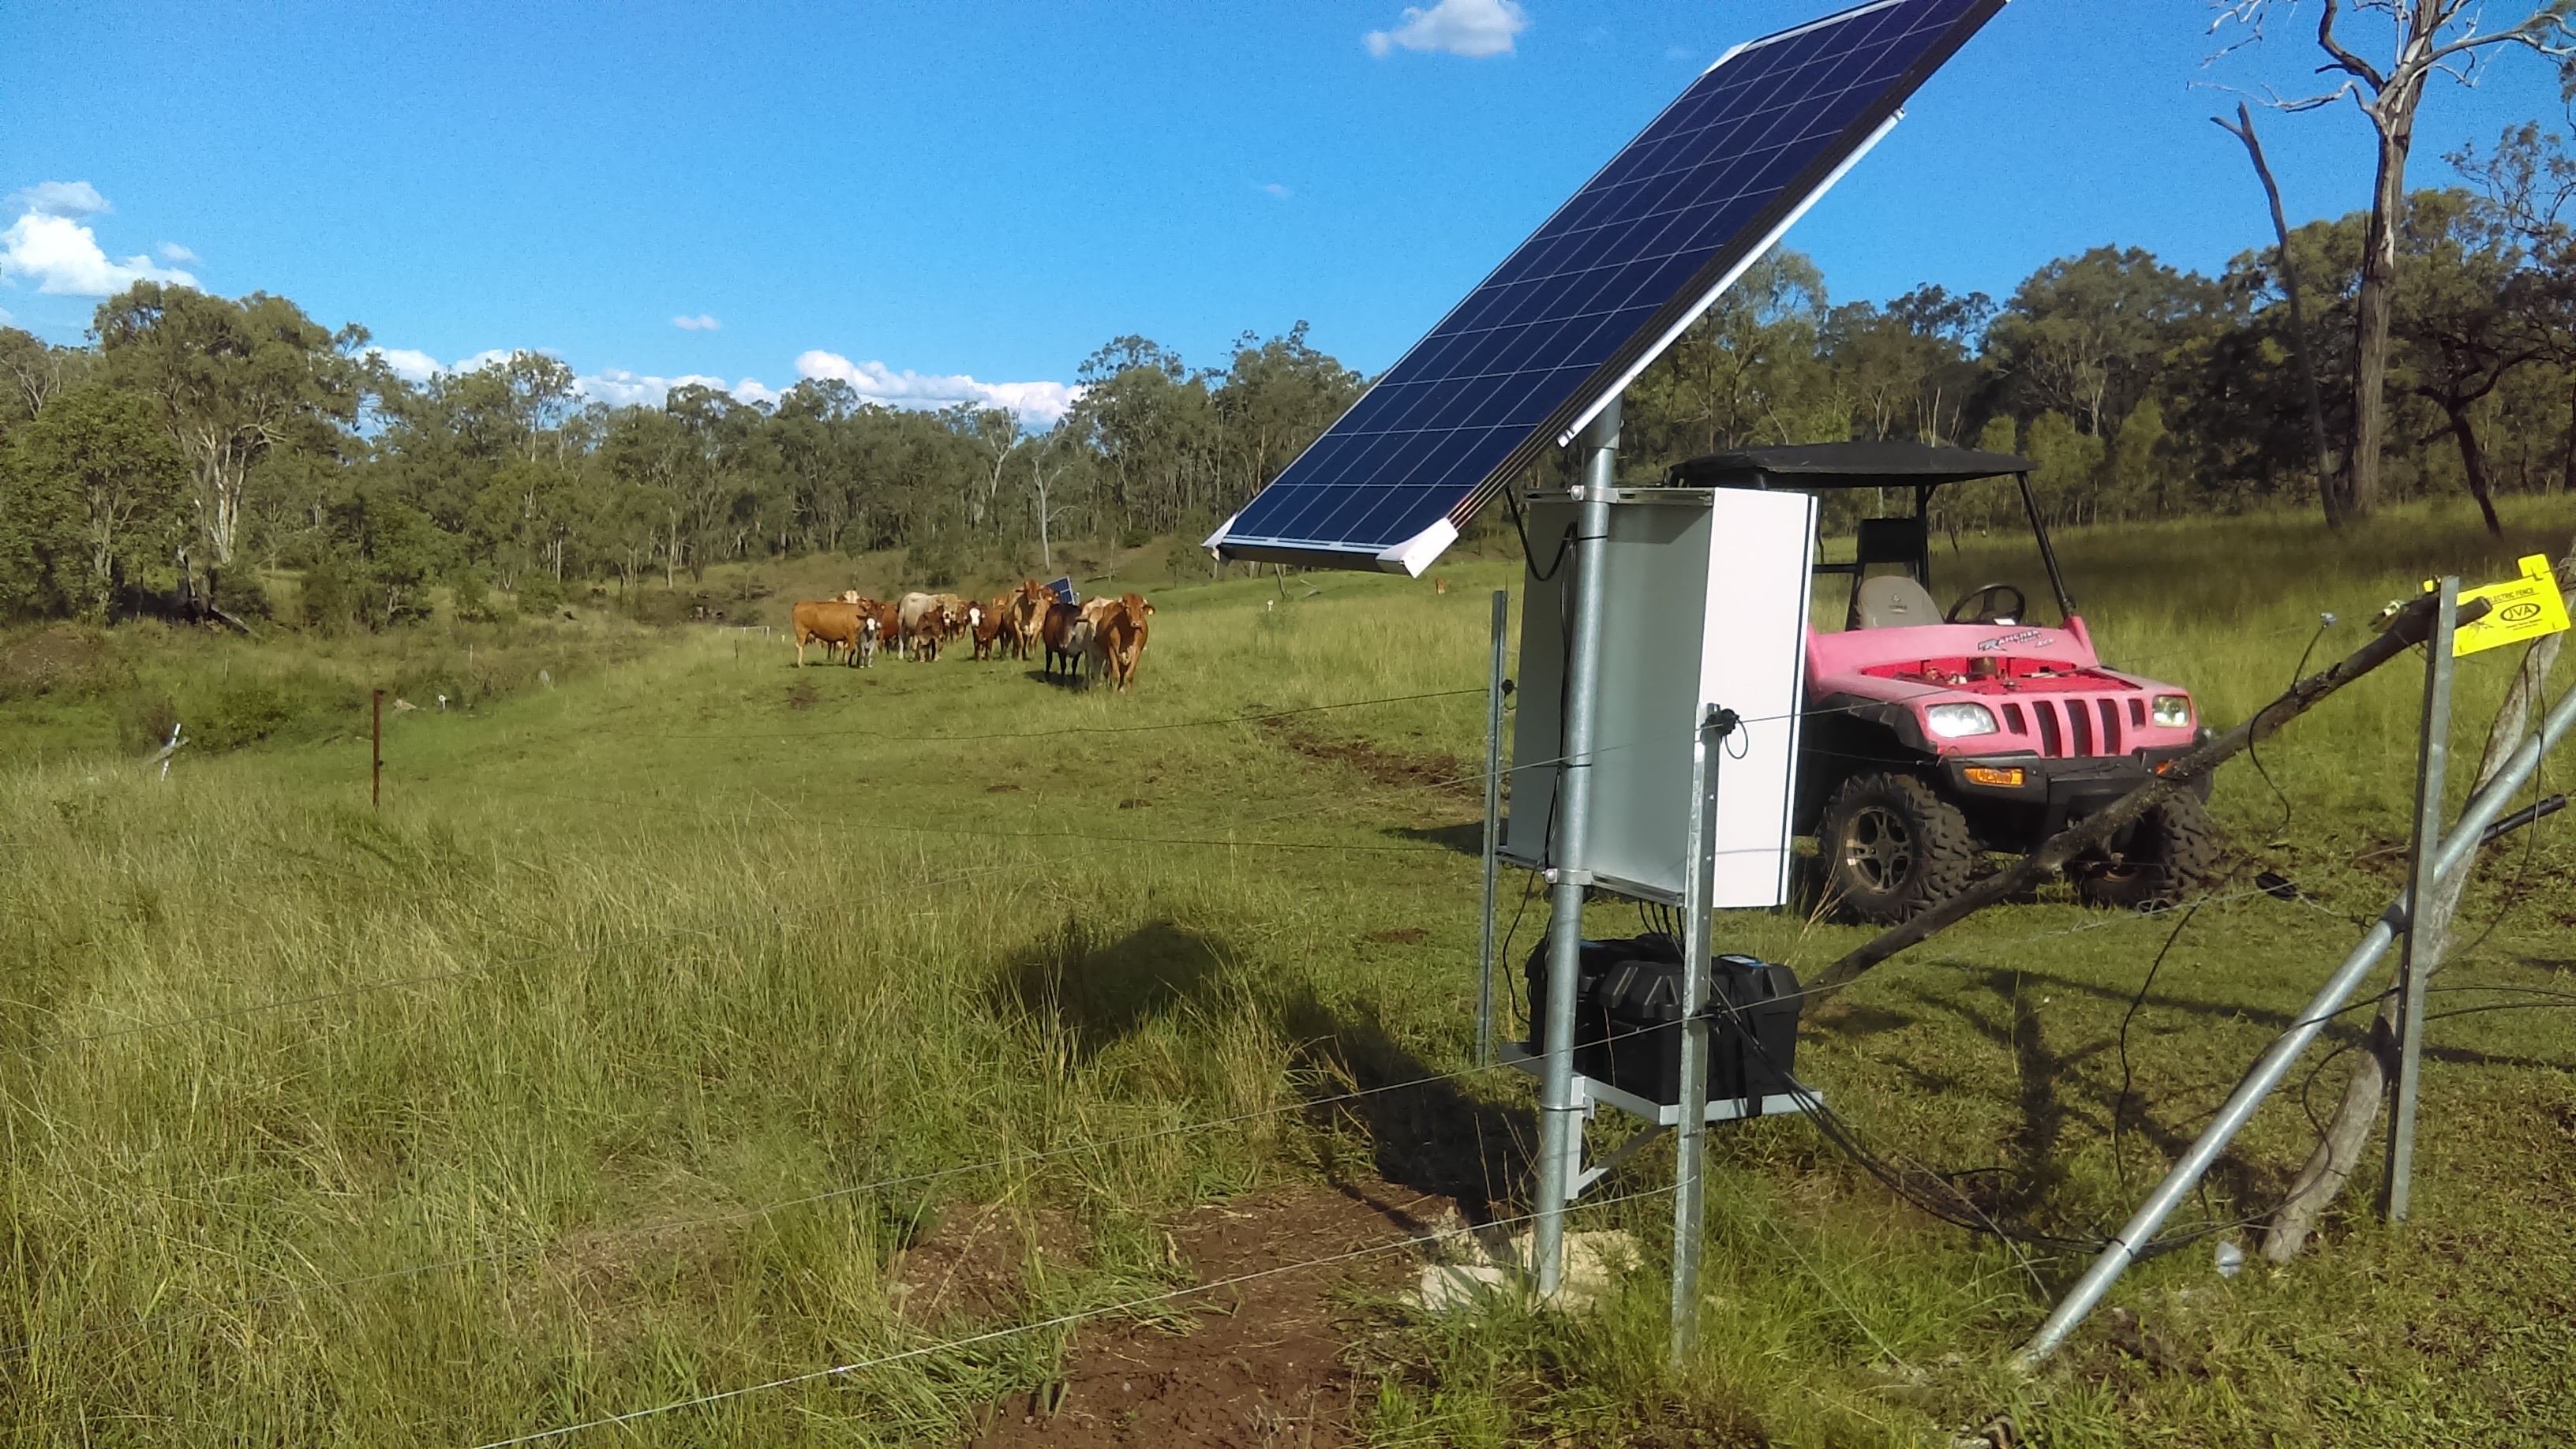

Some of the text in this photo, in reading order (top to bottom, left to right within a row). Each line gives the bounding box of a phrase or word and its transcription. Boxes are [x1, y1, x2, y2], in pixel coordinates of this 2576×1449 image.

[2515, 587, 2534, 597] FENCE
[2508, 605, 2533, 619] JVA
[1978, 629, 2041, 651] RANCHER
